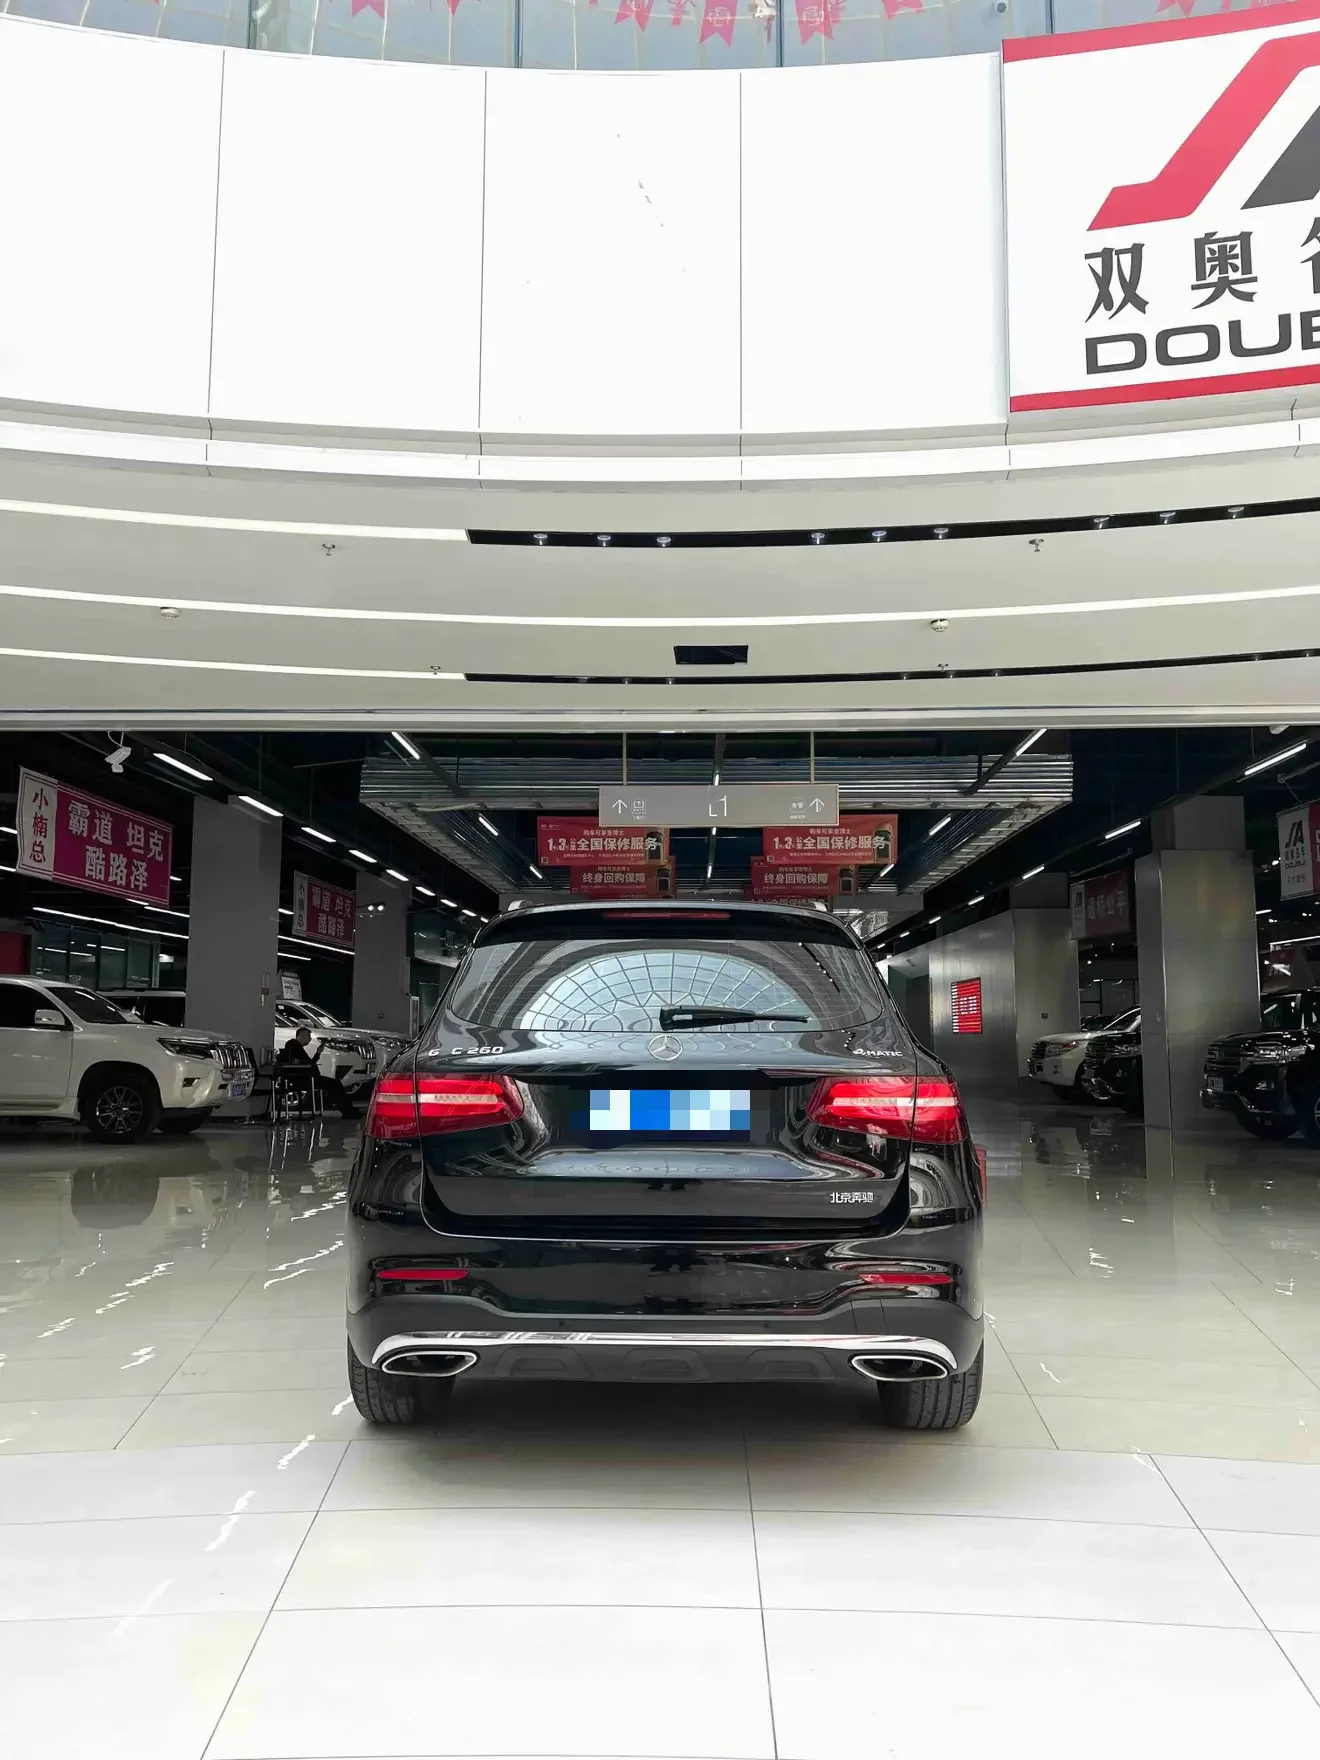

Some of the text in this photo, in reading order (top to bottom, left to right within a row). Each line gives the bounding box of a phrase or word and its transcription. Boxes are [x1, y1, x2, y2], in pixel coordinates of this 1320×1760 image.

[708, 795, 728, 817] L1
[29, 788, 49, 864] 小楠总
[68, 800, 164, 862] 霸道 坦克
[84, 844, 148, 892] 酷路泽
[582, 872, 646, 883] 终身回购保障
[764, 873, 829, 884] 终身回购保障
[428, 1046, 504, 1057] GC 260
[852, 1048, 904, 1057] 4MATIC
[829, 1191, 874, 1204] 北京奔驰
